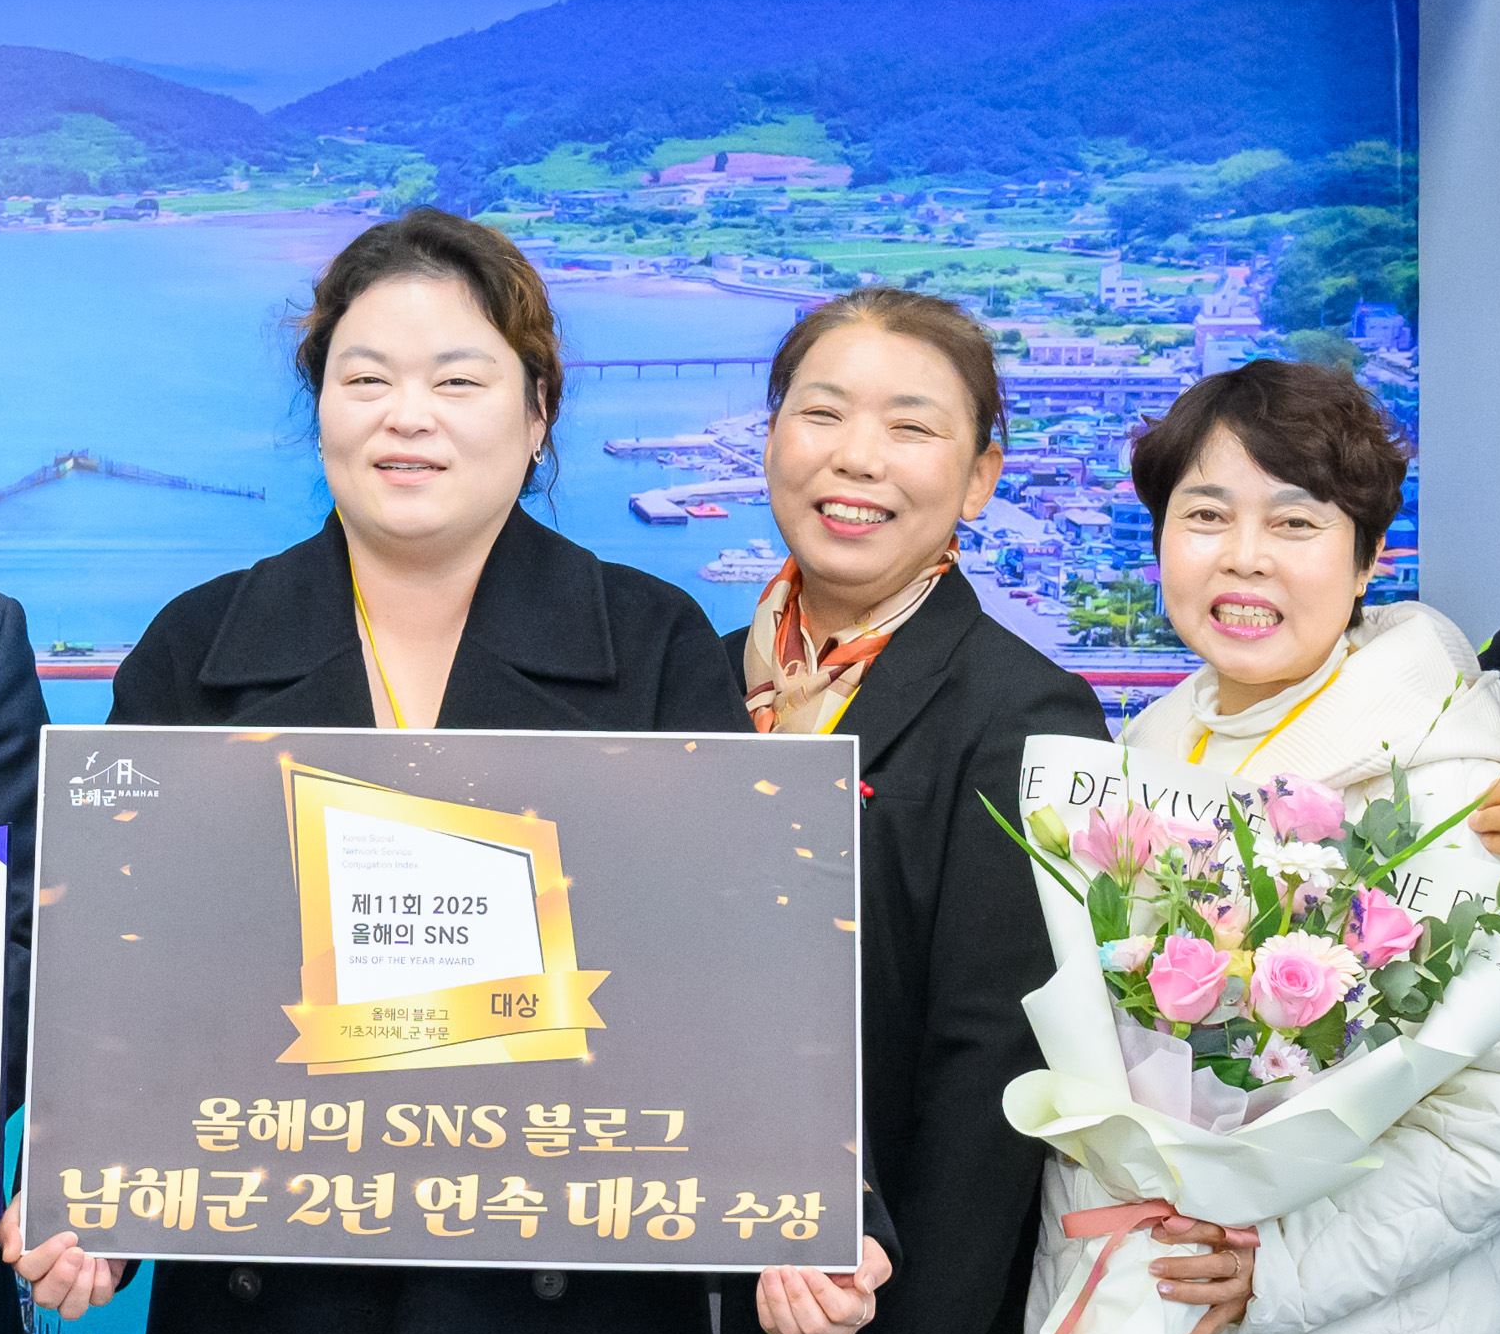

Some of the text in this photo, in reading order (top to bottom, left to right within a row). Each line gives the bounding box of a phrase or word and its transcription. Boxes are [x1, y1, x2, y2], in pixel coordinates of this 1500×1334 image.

[69, 788, 117, 806] 남해군
[342, 834, 394, 843] Korea Social
[342, 847, 413, 856] Network Service
[395, 860, 418, 869] Index
[352, 893, 488, 916] 제11회 2025
[352, 923, 469, 945] 올해의 SNS
[349, 956, 474, 966] SNS OF THE YEAR AWARD
[491, 993, 539, 1018] 대상
[372, 1007, 450, 1021] 올해의 블로그
[340, 1025, 450, 1040] 기초지자체_군 부문
[192, 1098, 689, 1158] 올해의 SNS 블로그
[59, 1167, 826, 1241] 남해군 2년 연속 대상 수상
